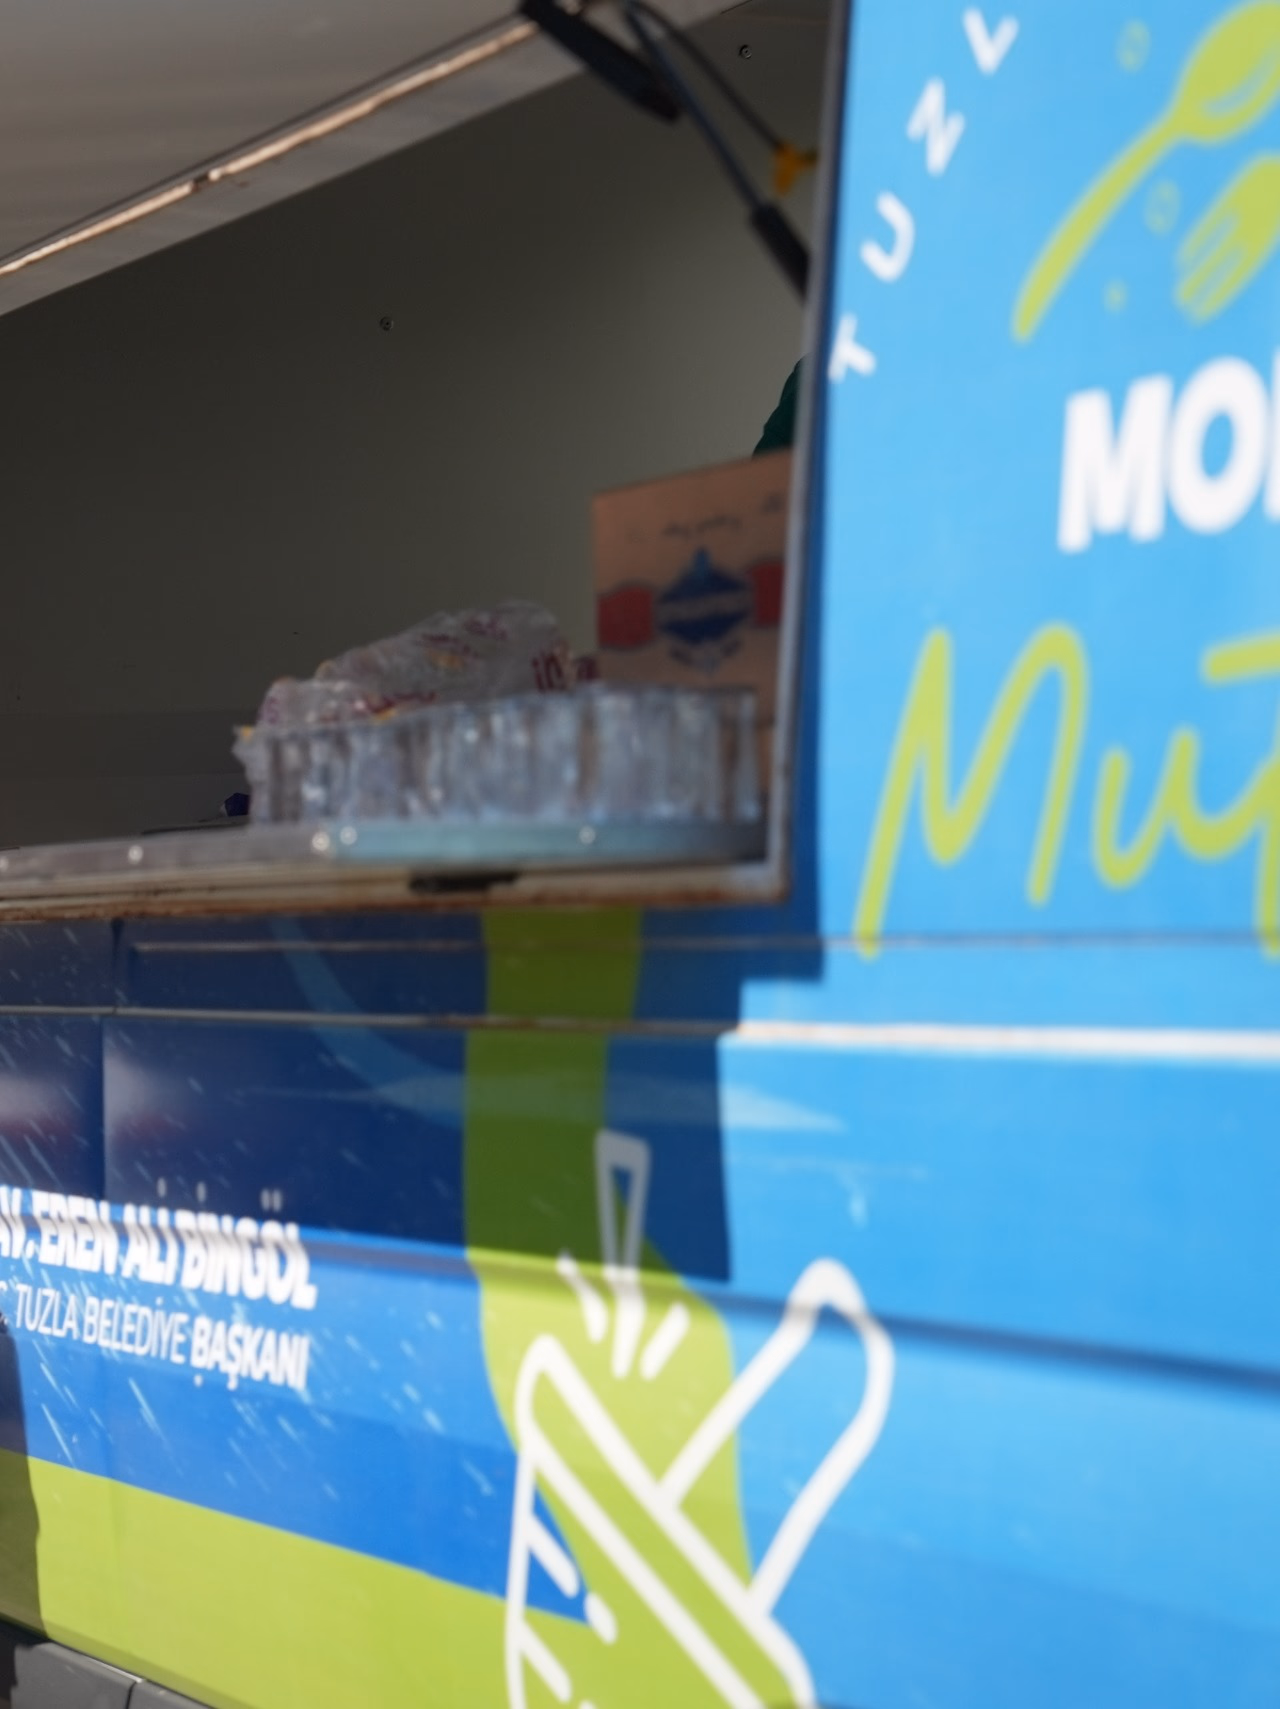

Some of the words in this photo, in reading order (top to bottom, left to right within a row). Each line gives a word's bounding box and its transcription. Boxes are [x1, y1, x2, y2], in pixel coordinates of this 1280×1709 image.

[1057, 348, 1280, 554] MO
[174, 1181, 318, 1311] BİNGÖL
[15, 1283, 82, 1341] TUZLA
[82, 1295, 190, 1365] BELEDİYE
[190, 1315, 310, 1391] BAŞKANI
